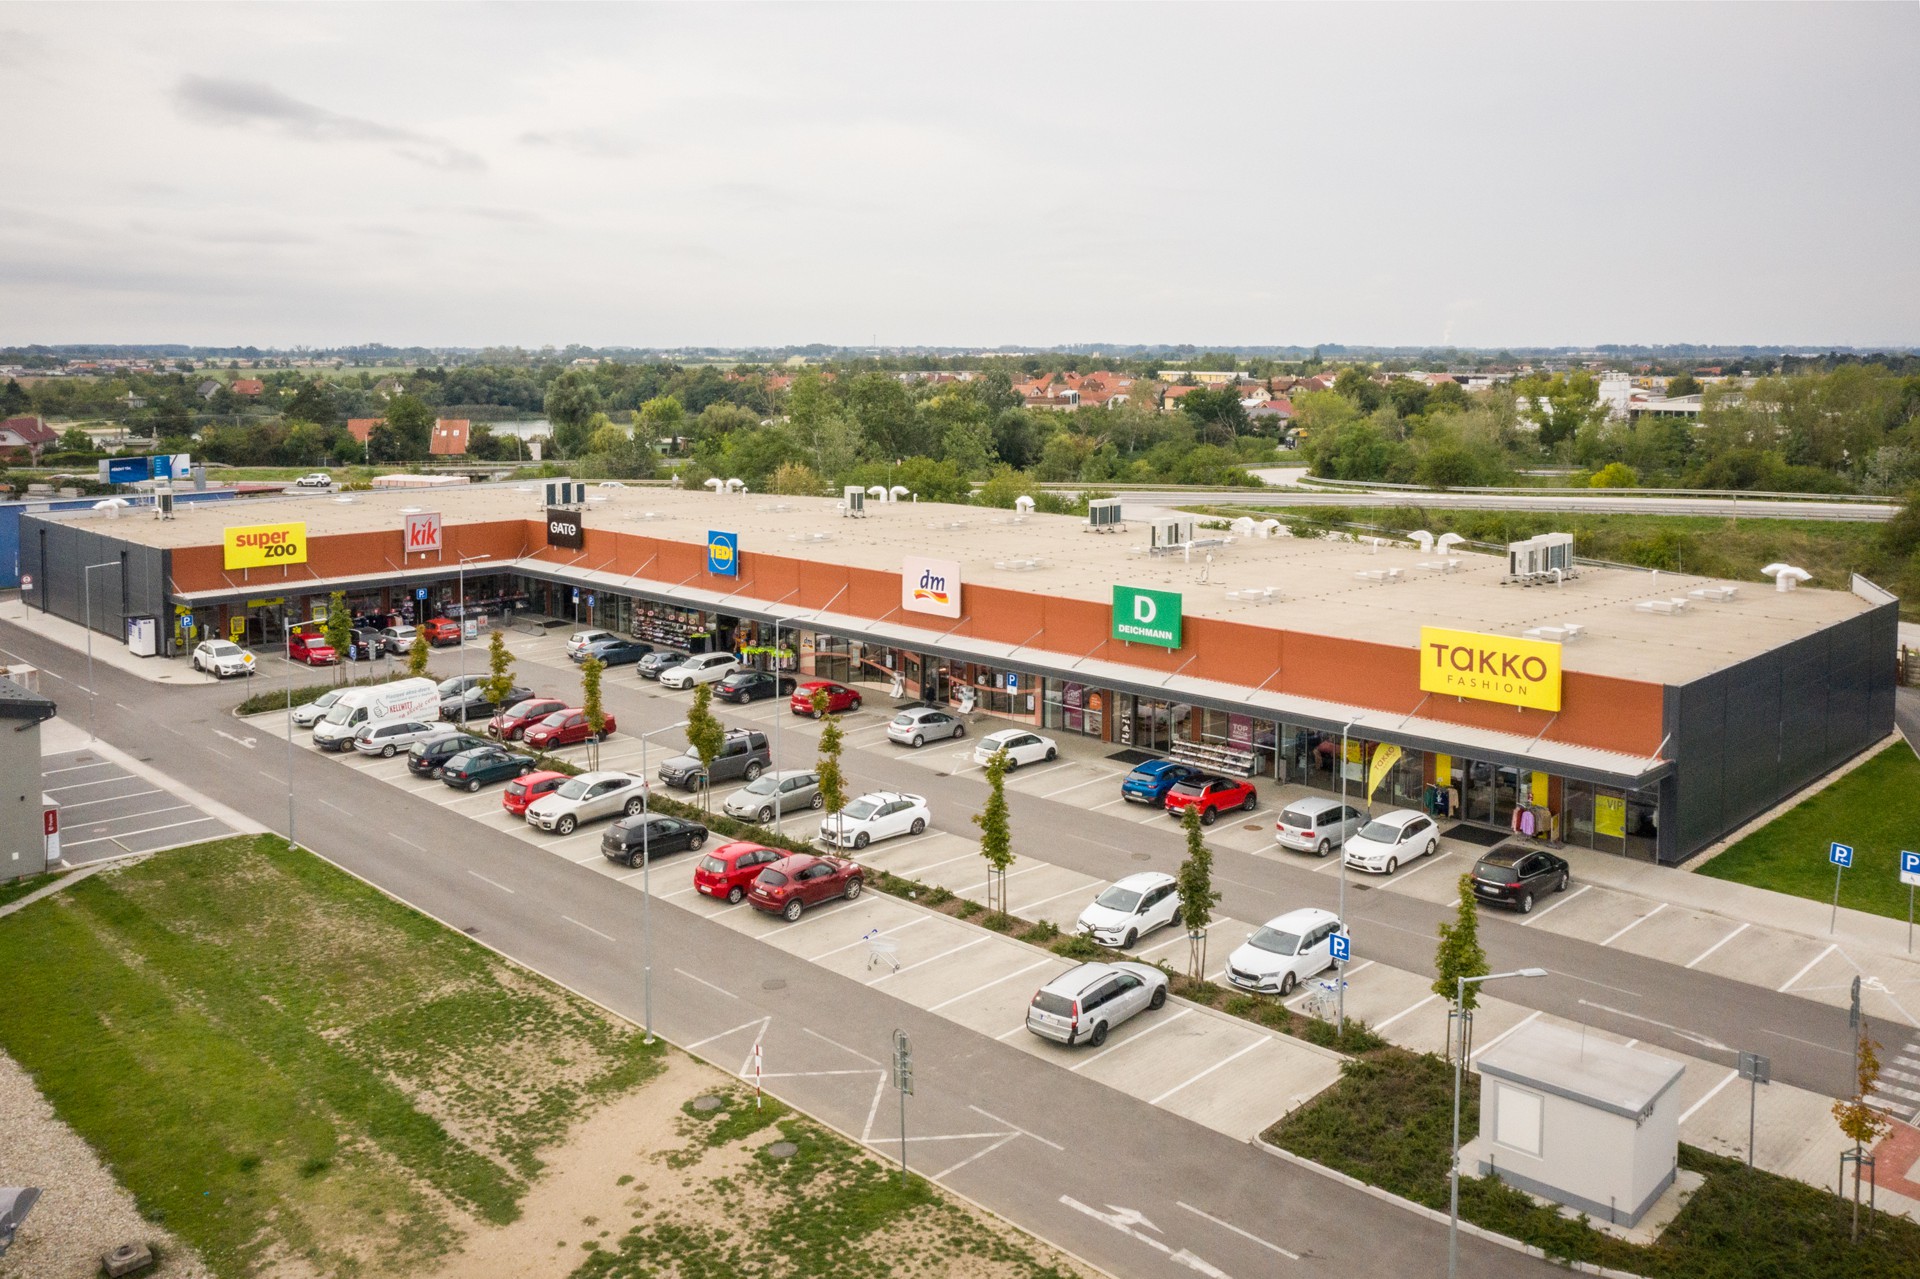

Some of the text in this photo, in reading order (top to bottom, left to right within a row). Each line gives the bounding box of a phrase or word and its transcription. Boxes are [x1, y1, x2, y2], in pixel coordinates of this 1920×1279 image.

[236, 530, 290, 549] super
[410, 518, 437, 546] kik
[264, 543, 297, 558] zoo
[920, 569, 945, 591] dm
[1134, 595, 1157, 623] D
[1118, 624, 1173, 640] DEICHMANN
[1447, 675, 1528, 696] FASHION
[1232, 723, 1249, 732] TOP
[1607, 799, 1623, 810] VIP
[1834, 846, 1848, 862] P
[1906, 854, 1919, 870] P
[1333, 937, 1346, 955] P
